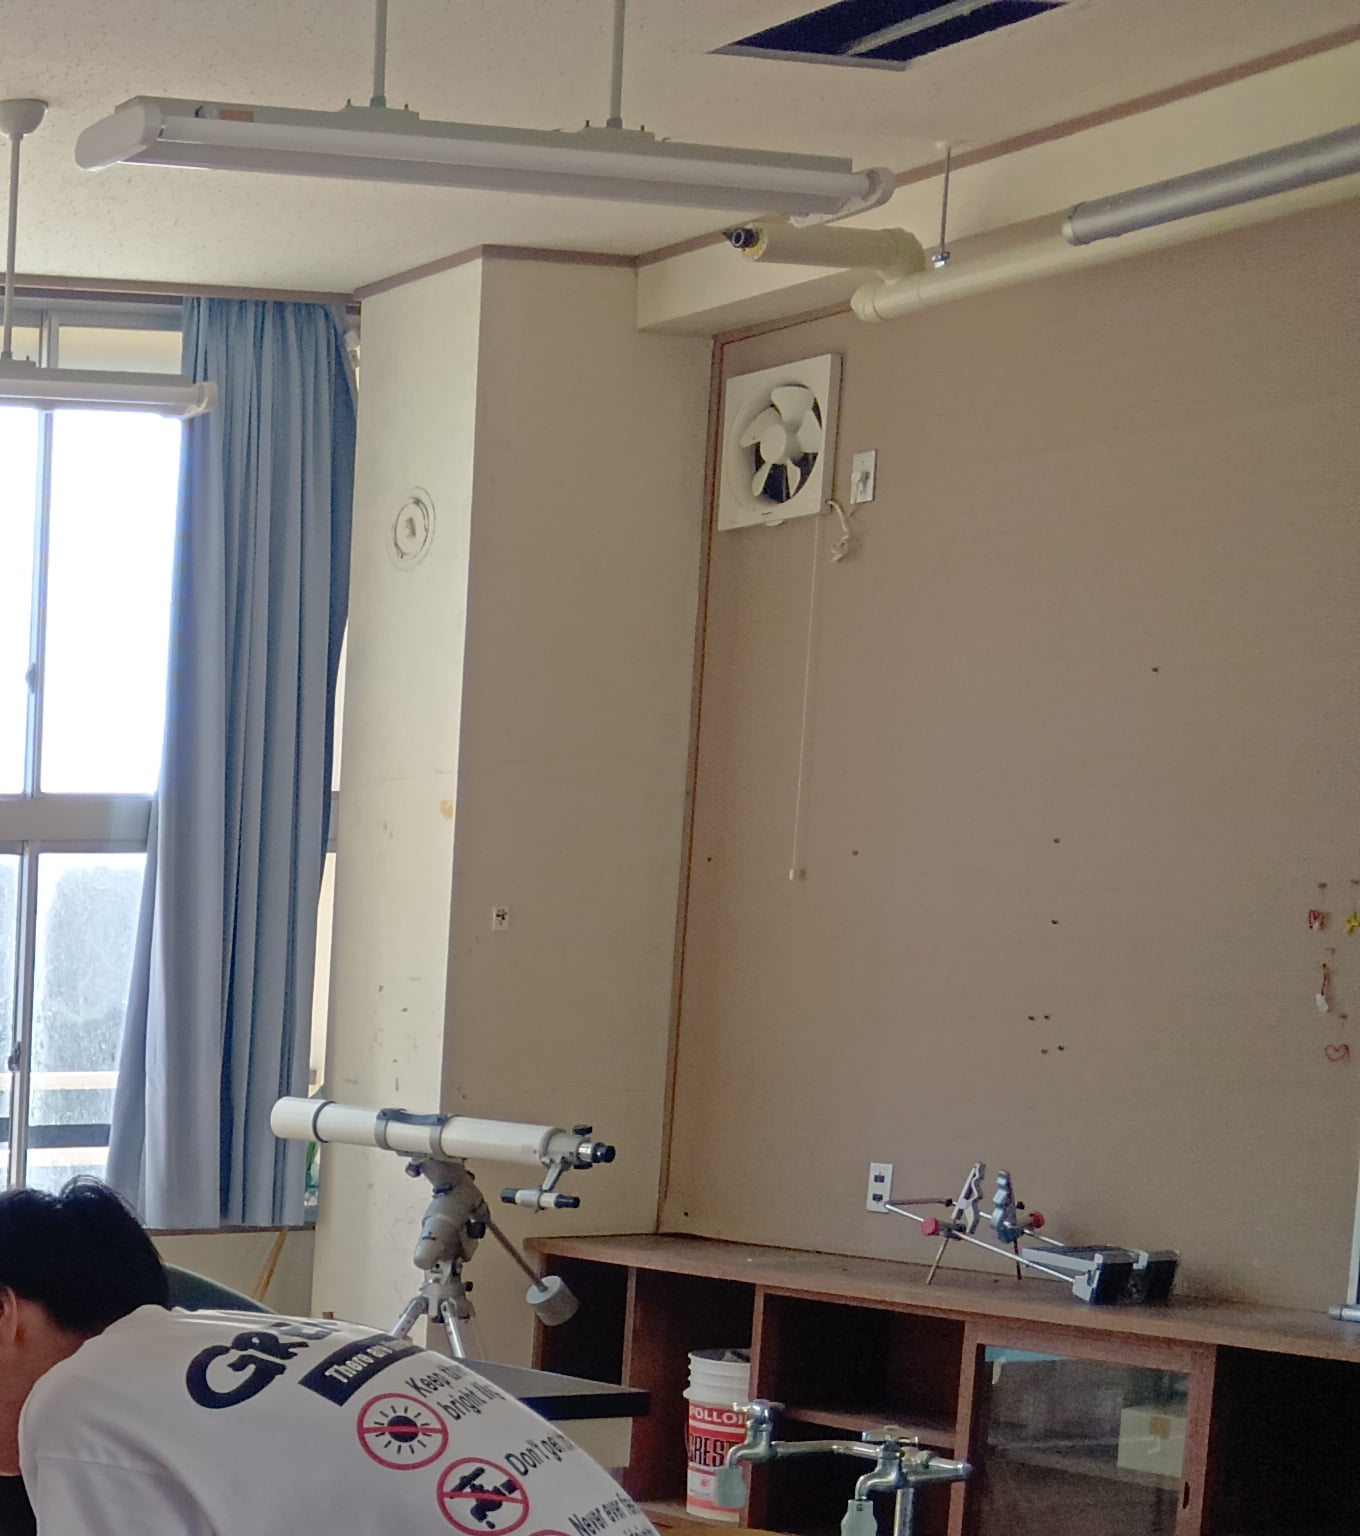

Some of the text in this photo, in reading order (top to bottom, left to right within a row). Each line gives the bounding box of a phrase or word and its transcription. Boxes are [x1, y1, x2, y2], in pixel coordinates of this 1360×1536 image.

[324, 1353, 375, 1383] There
[405, 1373, 454, 1398] Keep
[436, 1387, 488, 1420] bright
[505, 1440, 550, 1476] Don't
